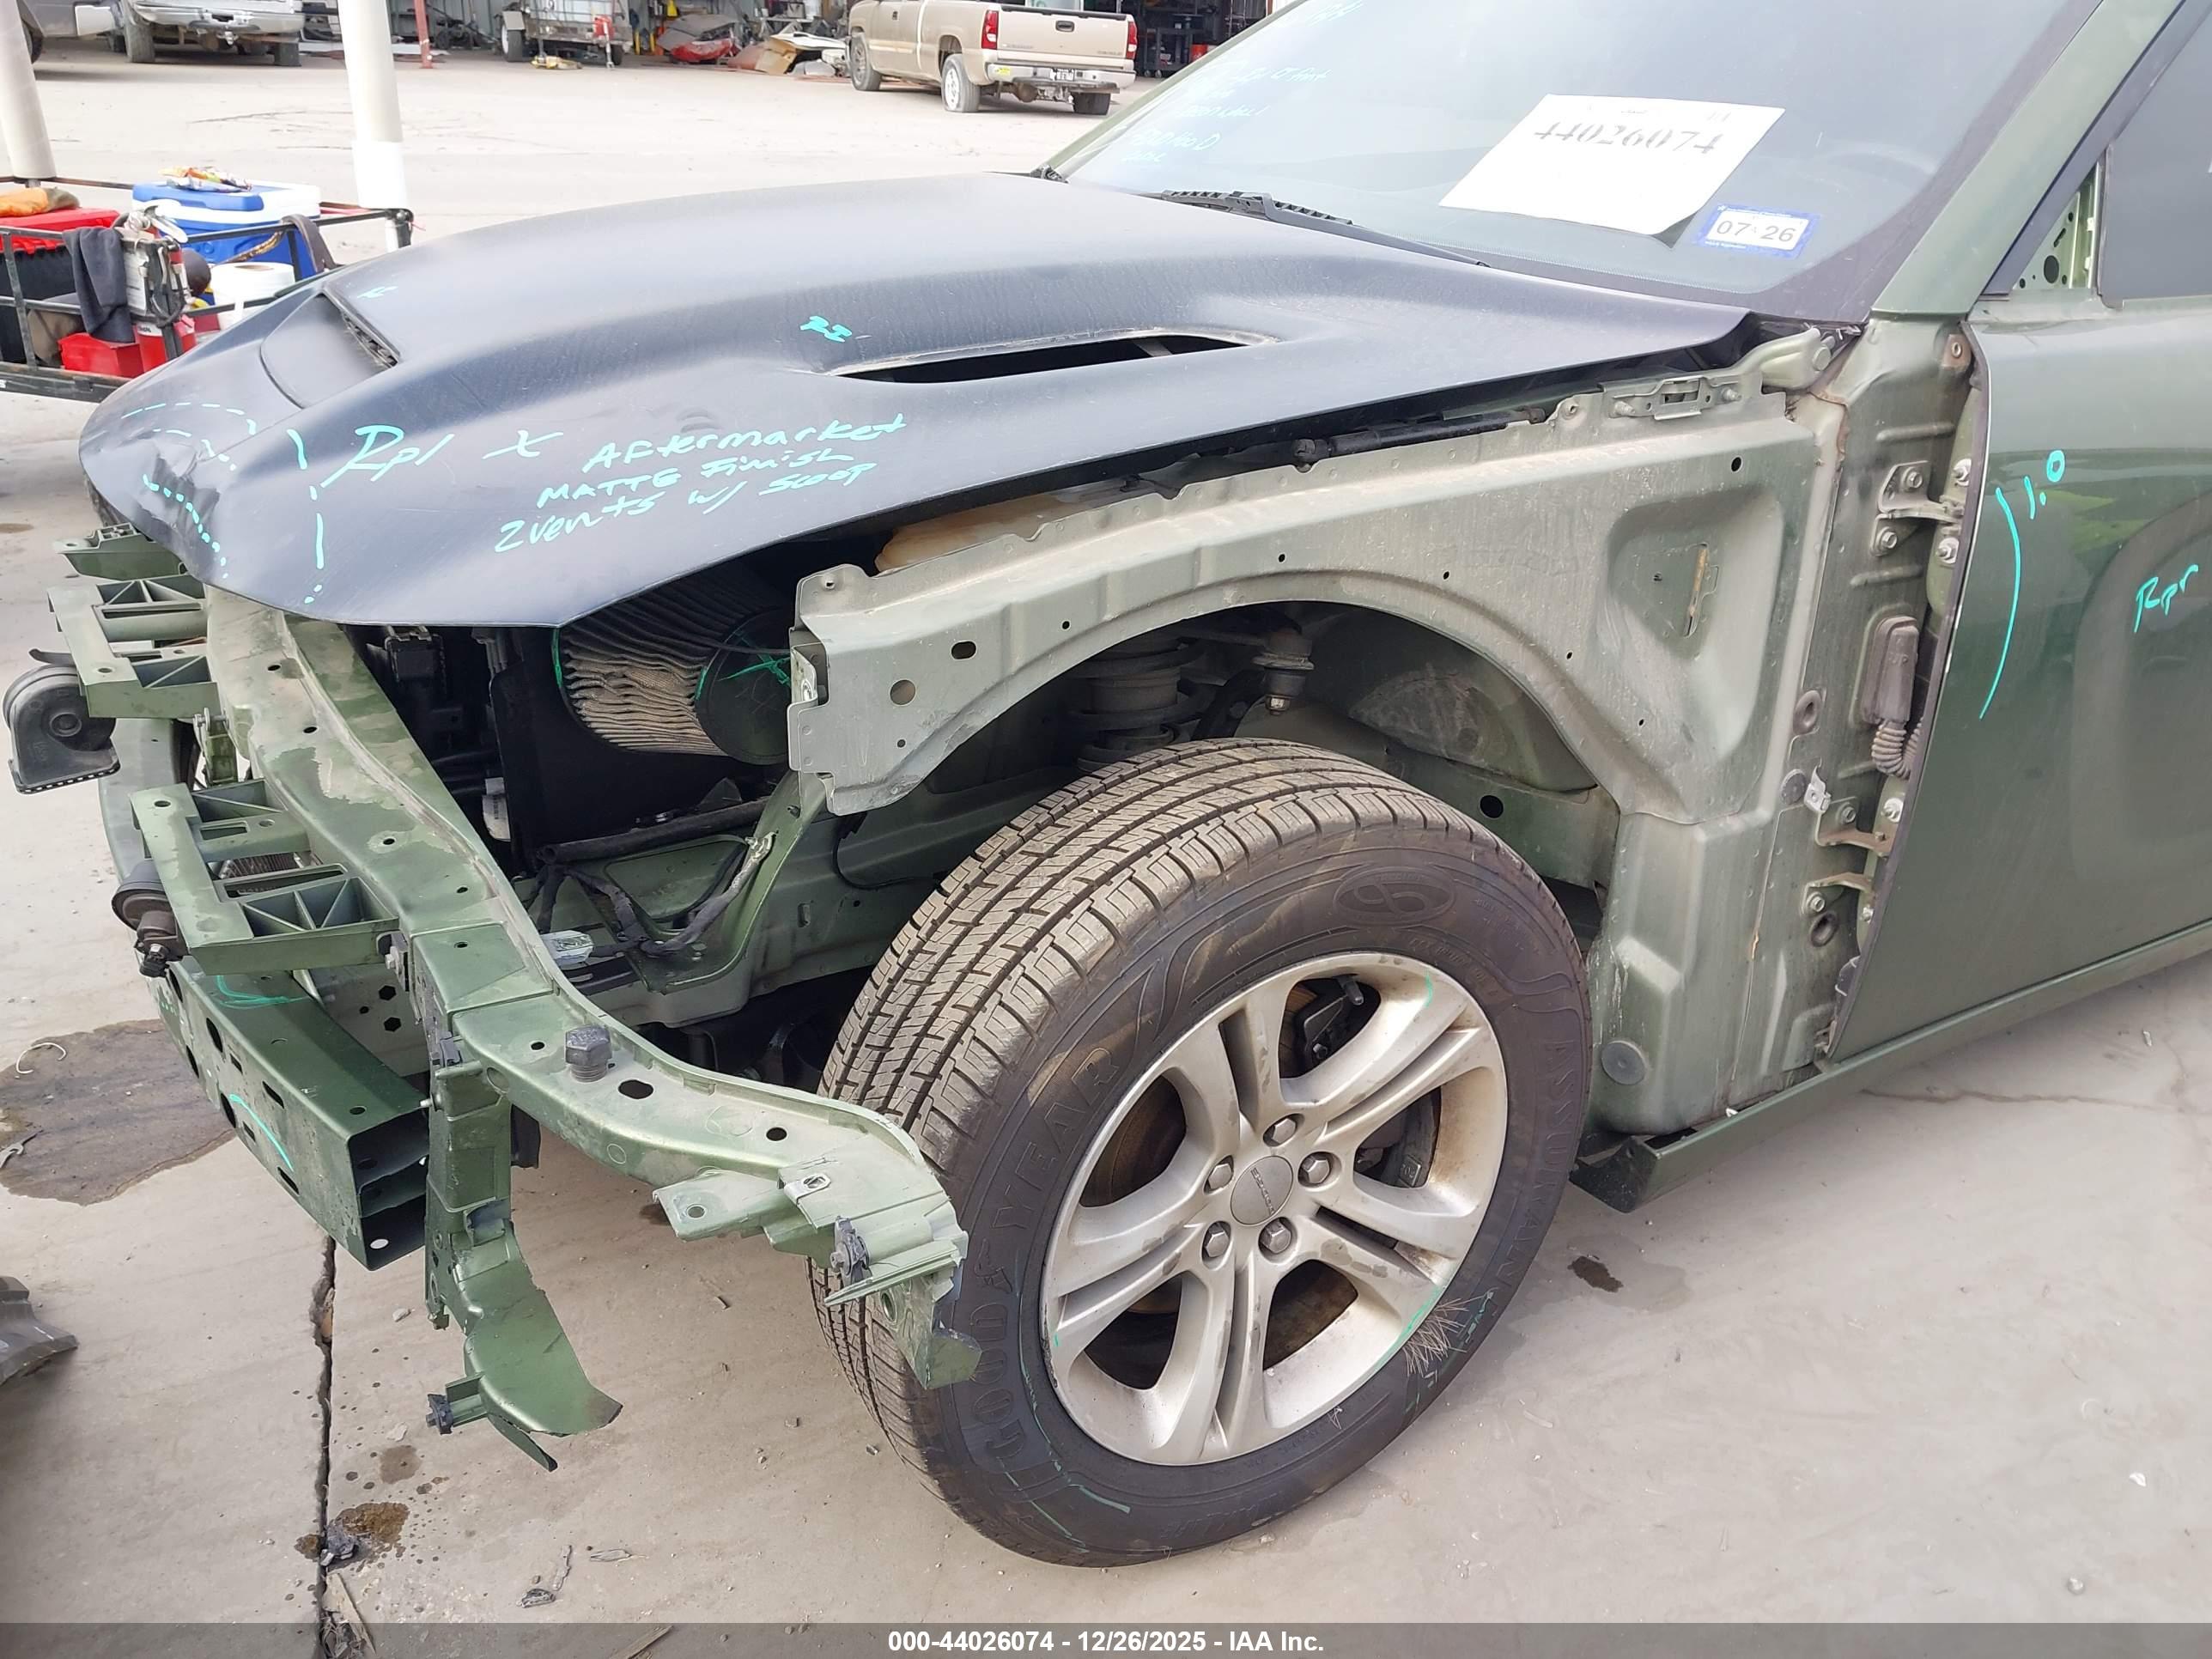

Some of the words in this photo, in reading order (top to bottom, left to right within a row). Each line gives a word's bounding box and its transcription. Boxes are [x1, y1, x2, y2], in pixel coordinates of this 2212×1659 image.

[1534, 119, 1724, 155] 44026074
[1717, 220, 1753, 236] 07
[1759, 225, 1796, 243] 26
